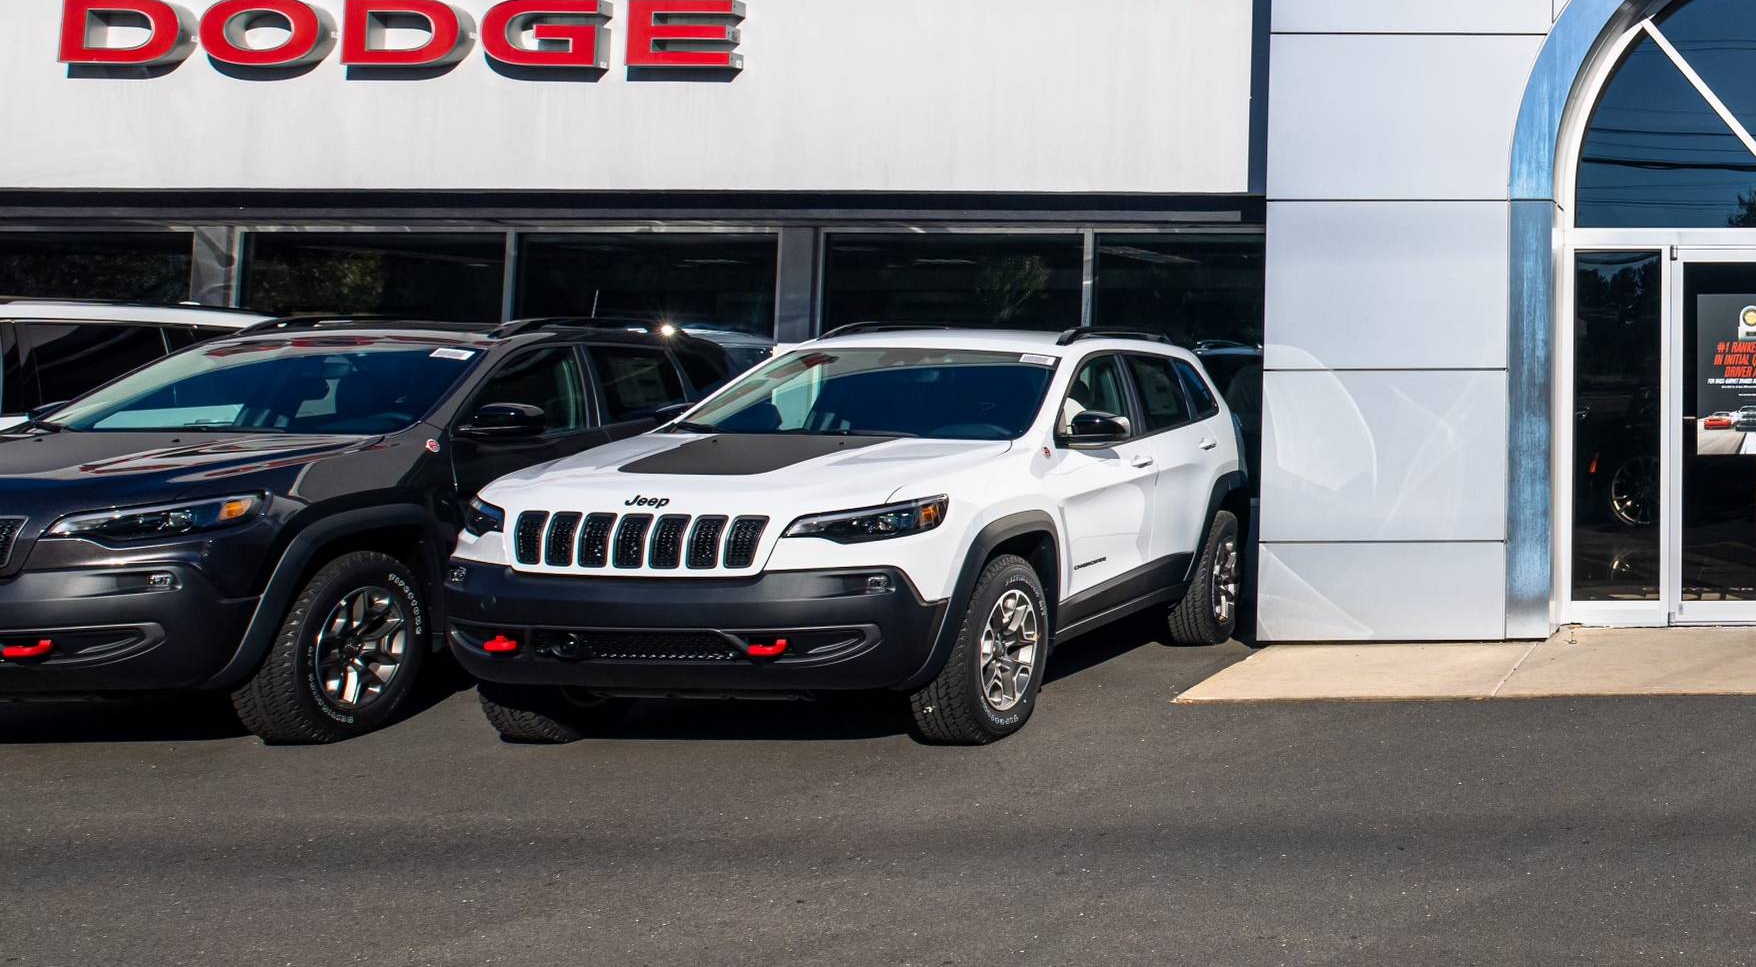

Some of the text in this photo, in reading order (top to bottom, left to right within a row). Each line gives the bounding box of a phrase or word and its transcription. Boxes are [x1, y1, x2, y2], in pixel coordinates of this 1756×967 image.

[1717, 341, 1730, 353] #1
[1713, 354, 1723, 366] IN
[1723, 354, 1751, 366] INITIAL
[1724, 366, 1753, 378] DRIVER
[624, 494, 670, 509] Jeep
